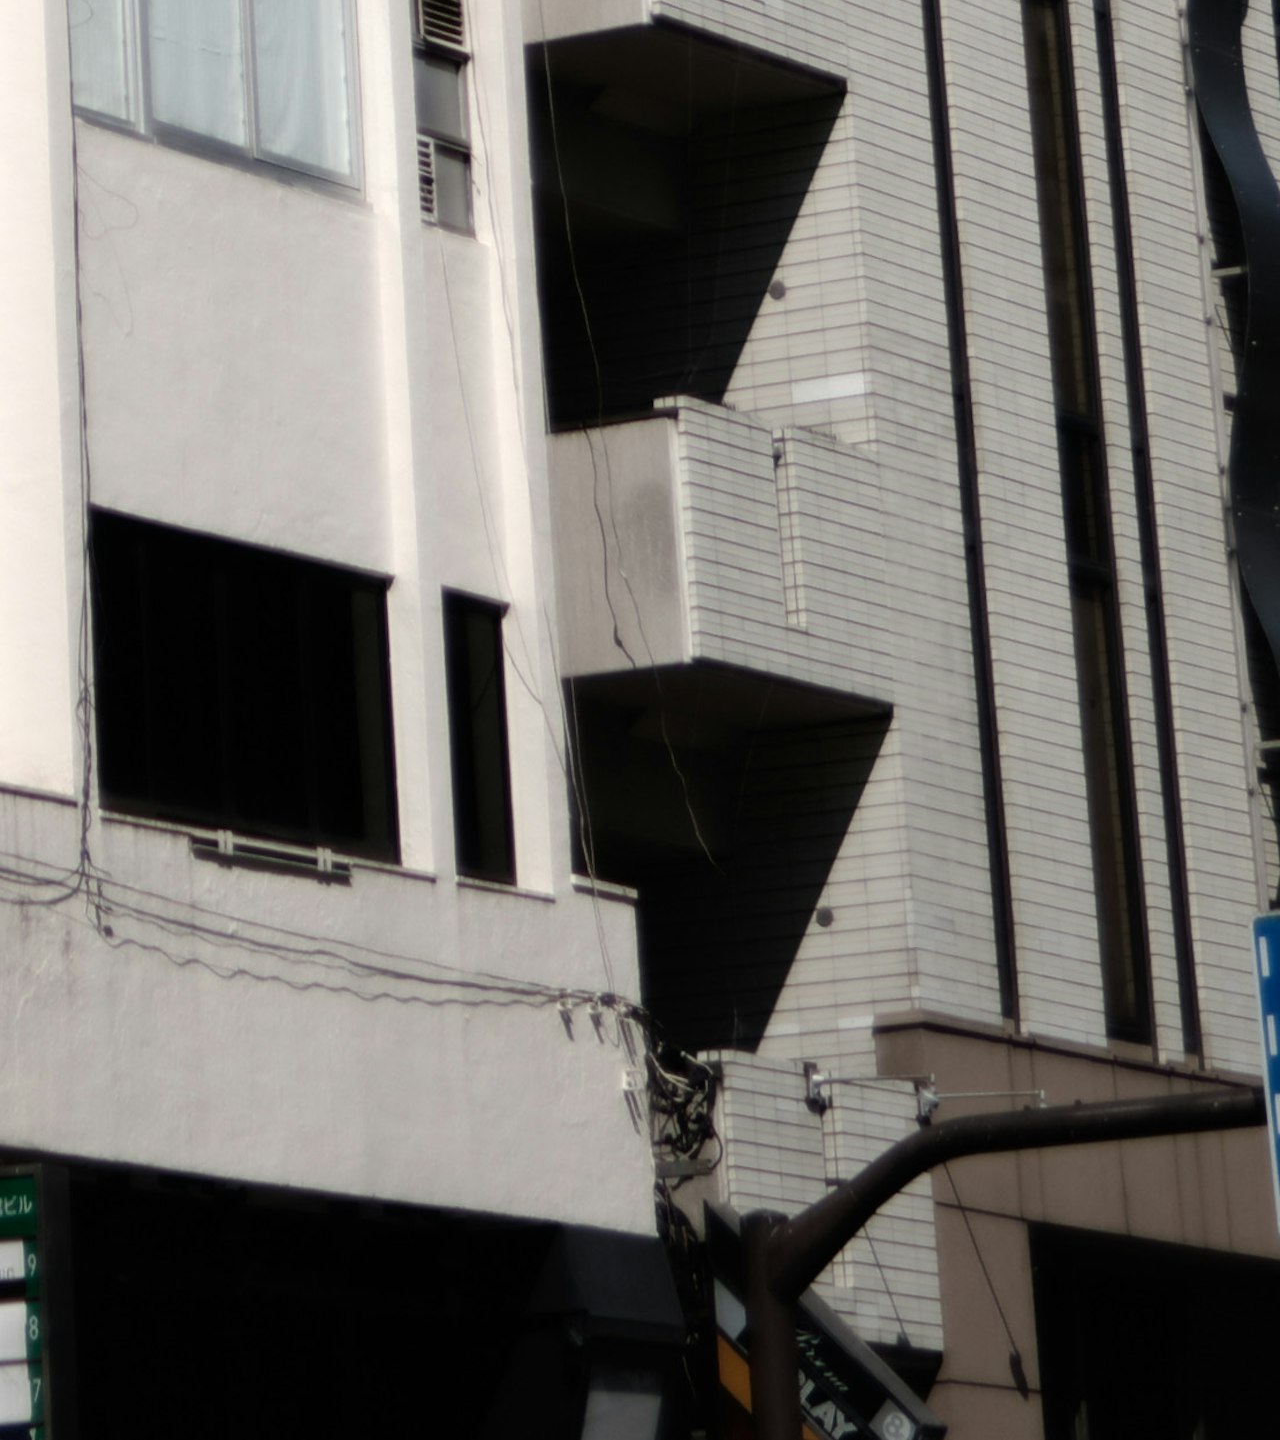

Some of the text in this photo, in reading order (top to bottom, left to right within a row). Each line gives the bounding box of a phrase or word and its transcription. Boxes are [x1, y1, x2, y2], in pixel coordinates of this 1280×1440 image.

[27, 1253, 37, 1277] 9
[28, 1315, 39, 1341] 8
[30, 1378, 42, 1404] 7
